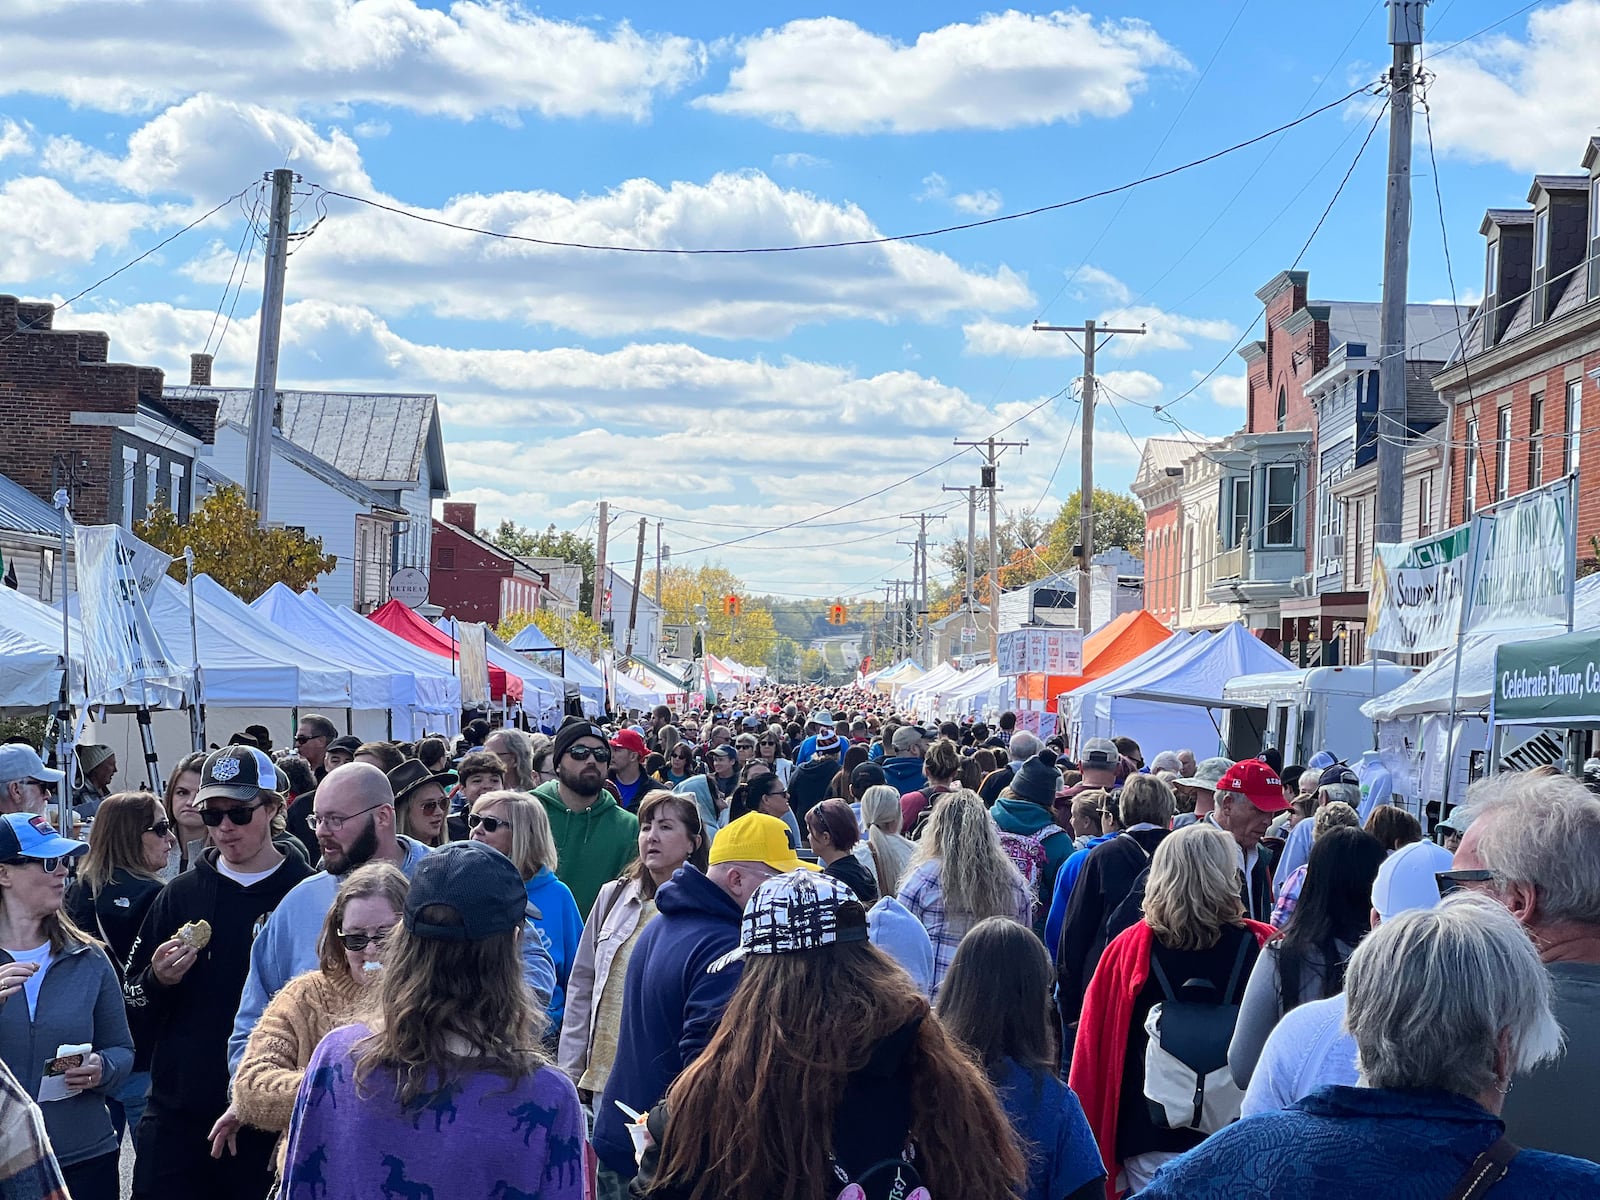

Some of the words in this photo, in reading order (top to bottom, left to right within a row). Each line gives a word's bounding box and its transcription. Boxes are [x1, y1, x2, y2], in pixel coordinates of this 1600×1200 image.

[391, 585, 427, 593] RETREAT
[1502, 668, 1547, 700] Celebrate
[1548, 664, 1584, 700] Flavor,
[1586, 661, 1600, 694] Ce
